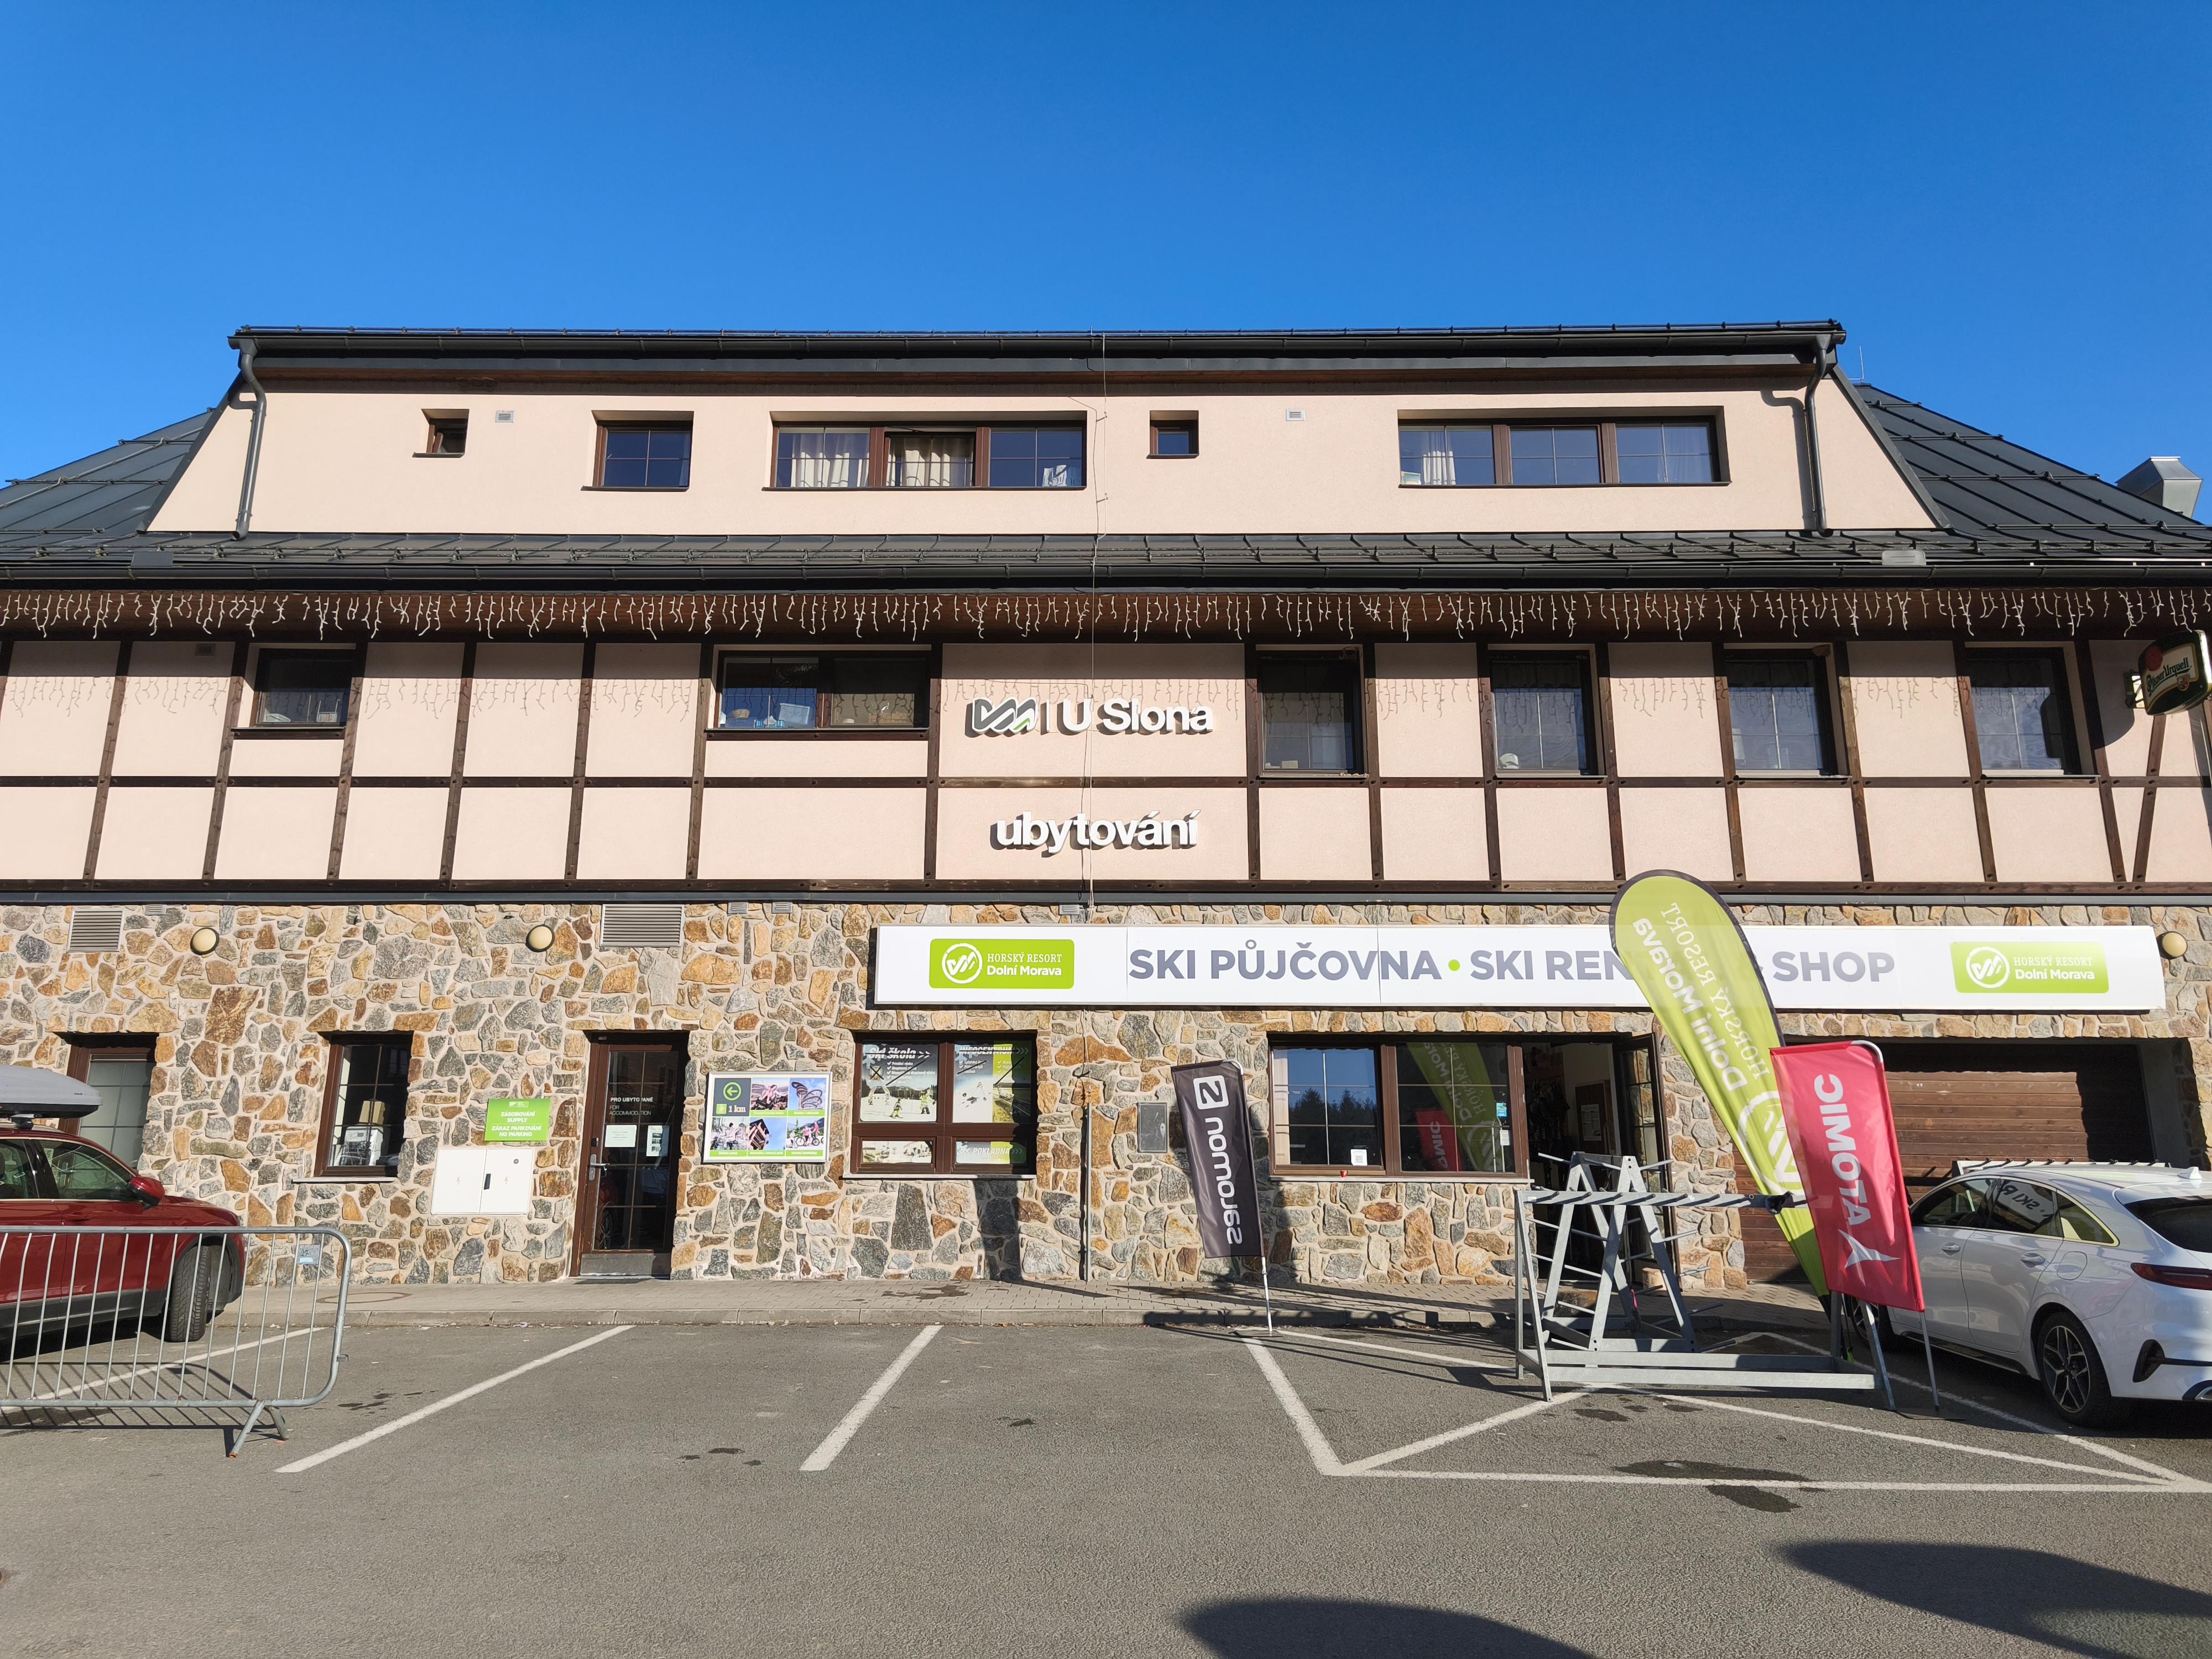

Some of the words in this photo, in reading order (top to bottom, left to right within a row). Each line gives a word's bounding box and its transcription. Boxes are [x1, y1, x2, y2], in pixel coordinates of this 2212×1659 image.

[2163, 657, 2189, 677] Urquell
[1062, 697, 1092, 733] U
[1102, 697, 1213, 733] Slona
[996, 809, 1202, 854] ubytování
[987, 952, 1025, 963] HORSKÝ
[1026, 953, 1062, 963] RESORT
[1128, 948, 1196, 980] SKI
[1211, 938, 1442, 981] PŮJČOVNA
[1469, 950, 1534, 980] SKI
[1546, 950, 1636, 980] REN
[1772, 951, 1895, 982] SHOP
[2013, 955, 2053, 966] HORSKÝ
[2056, 957, 2093, 967] RESORT
[987, 964, 1018, 975] Dolní
[1020, 966, 1062, 976] Morava
[2015, 968, 2048, 979] Dolní
[2049, 969, 2095, 980] Morava
[734, 1104, 746, 1113] km
